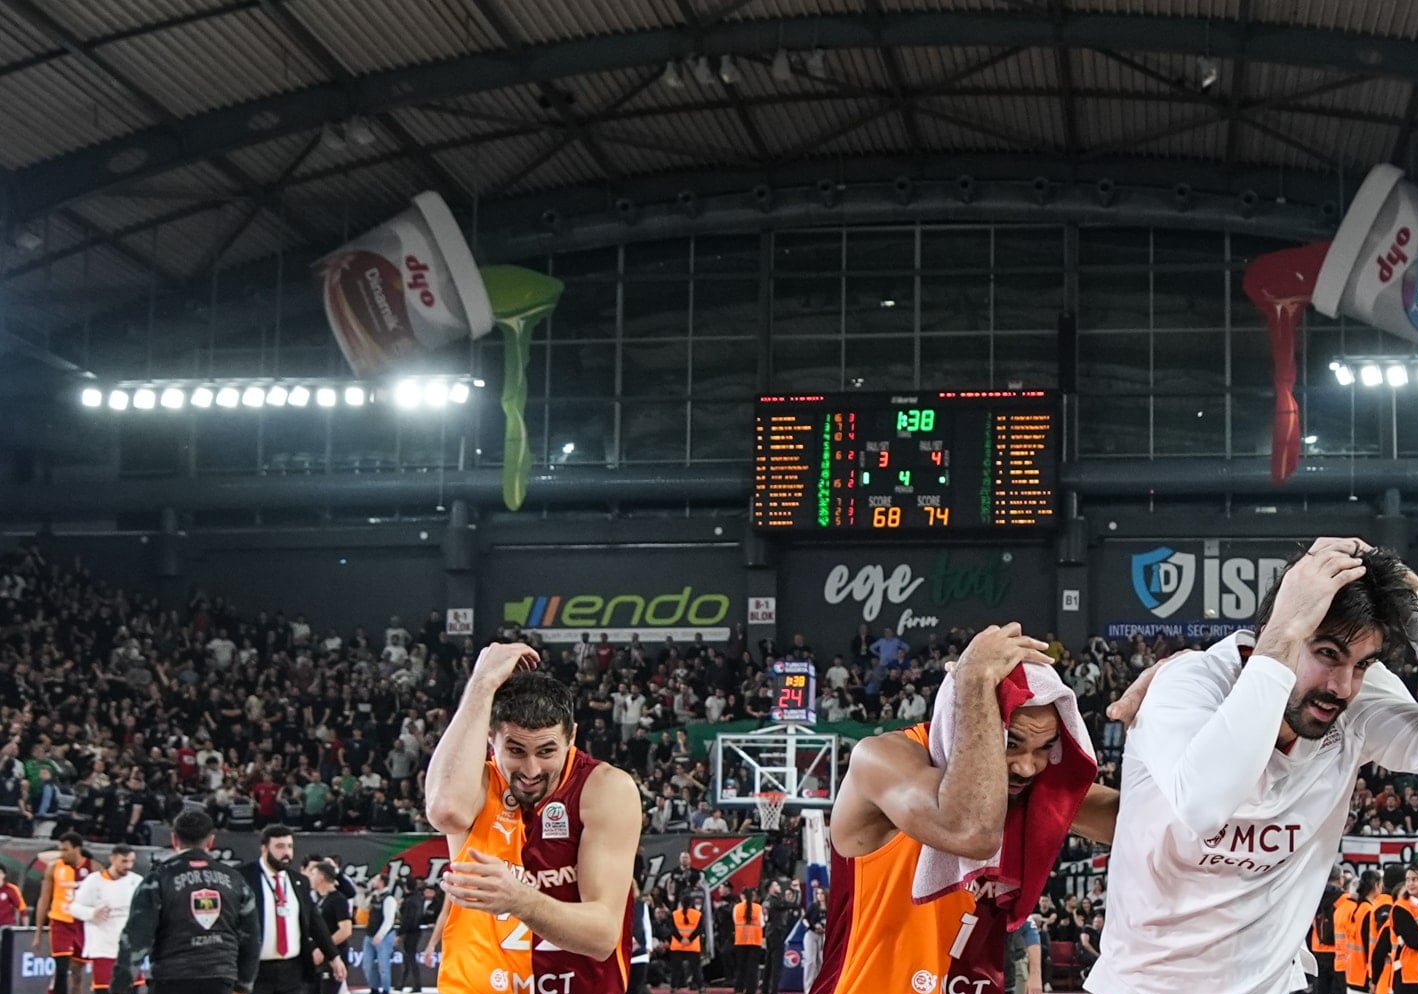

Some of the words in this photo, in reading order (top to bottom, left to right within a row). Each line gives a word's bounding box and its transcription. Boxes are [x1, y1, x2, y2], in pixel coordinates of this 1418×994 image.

[1377, 227, 1411, 283] dyo
[405, 254, 436, 308] dyo
[897, 409, 935, 432] 1:38
[879, 451, 889, 468] 3
[931, 451, 942, 466] 4
[899, 470, 911, 487] 4
[873, 507, 900, 528] 68
[923, 506, 949, 526] 74
[824, 563, 925, 622] ege
[1065, 594, 1078, 606] B1
[561, 586, 730, 627] endo
[779, 688, 803, 708] 24
[1230, 824, 1301, 853] MCT
[173, 869, 202, 891] SPOR
